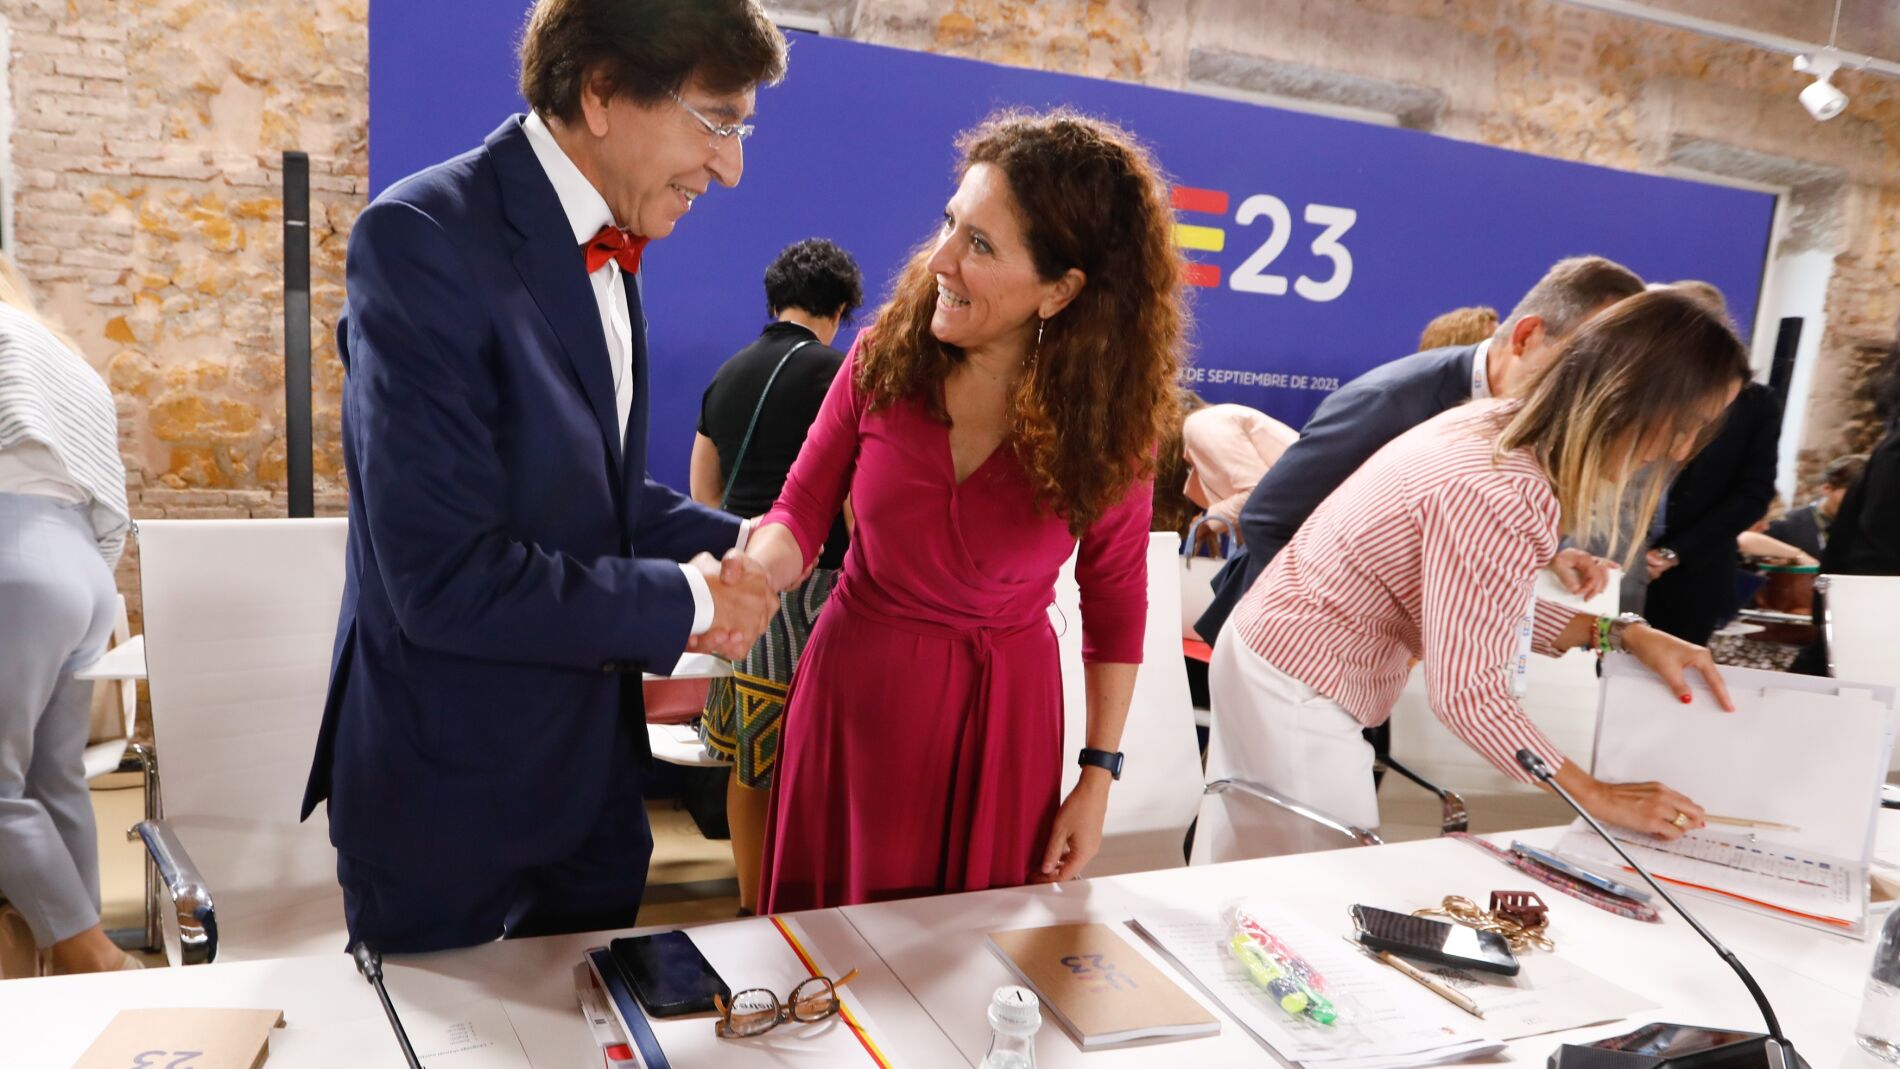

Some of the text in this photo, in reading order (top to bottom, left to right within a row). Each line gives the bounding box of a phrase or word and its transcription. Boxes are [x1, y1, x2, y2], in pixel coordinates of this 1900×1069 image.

[1186, 368, 1205, 382] DE
[1207, 369, 1288, 388] SEPTIEMBRE
[1290, 375, 1308, 390] DE
[1309, 377, 1340, 391] 2023
